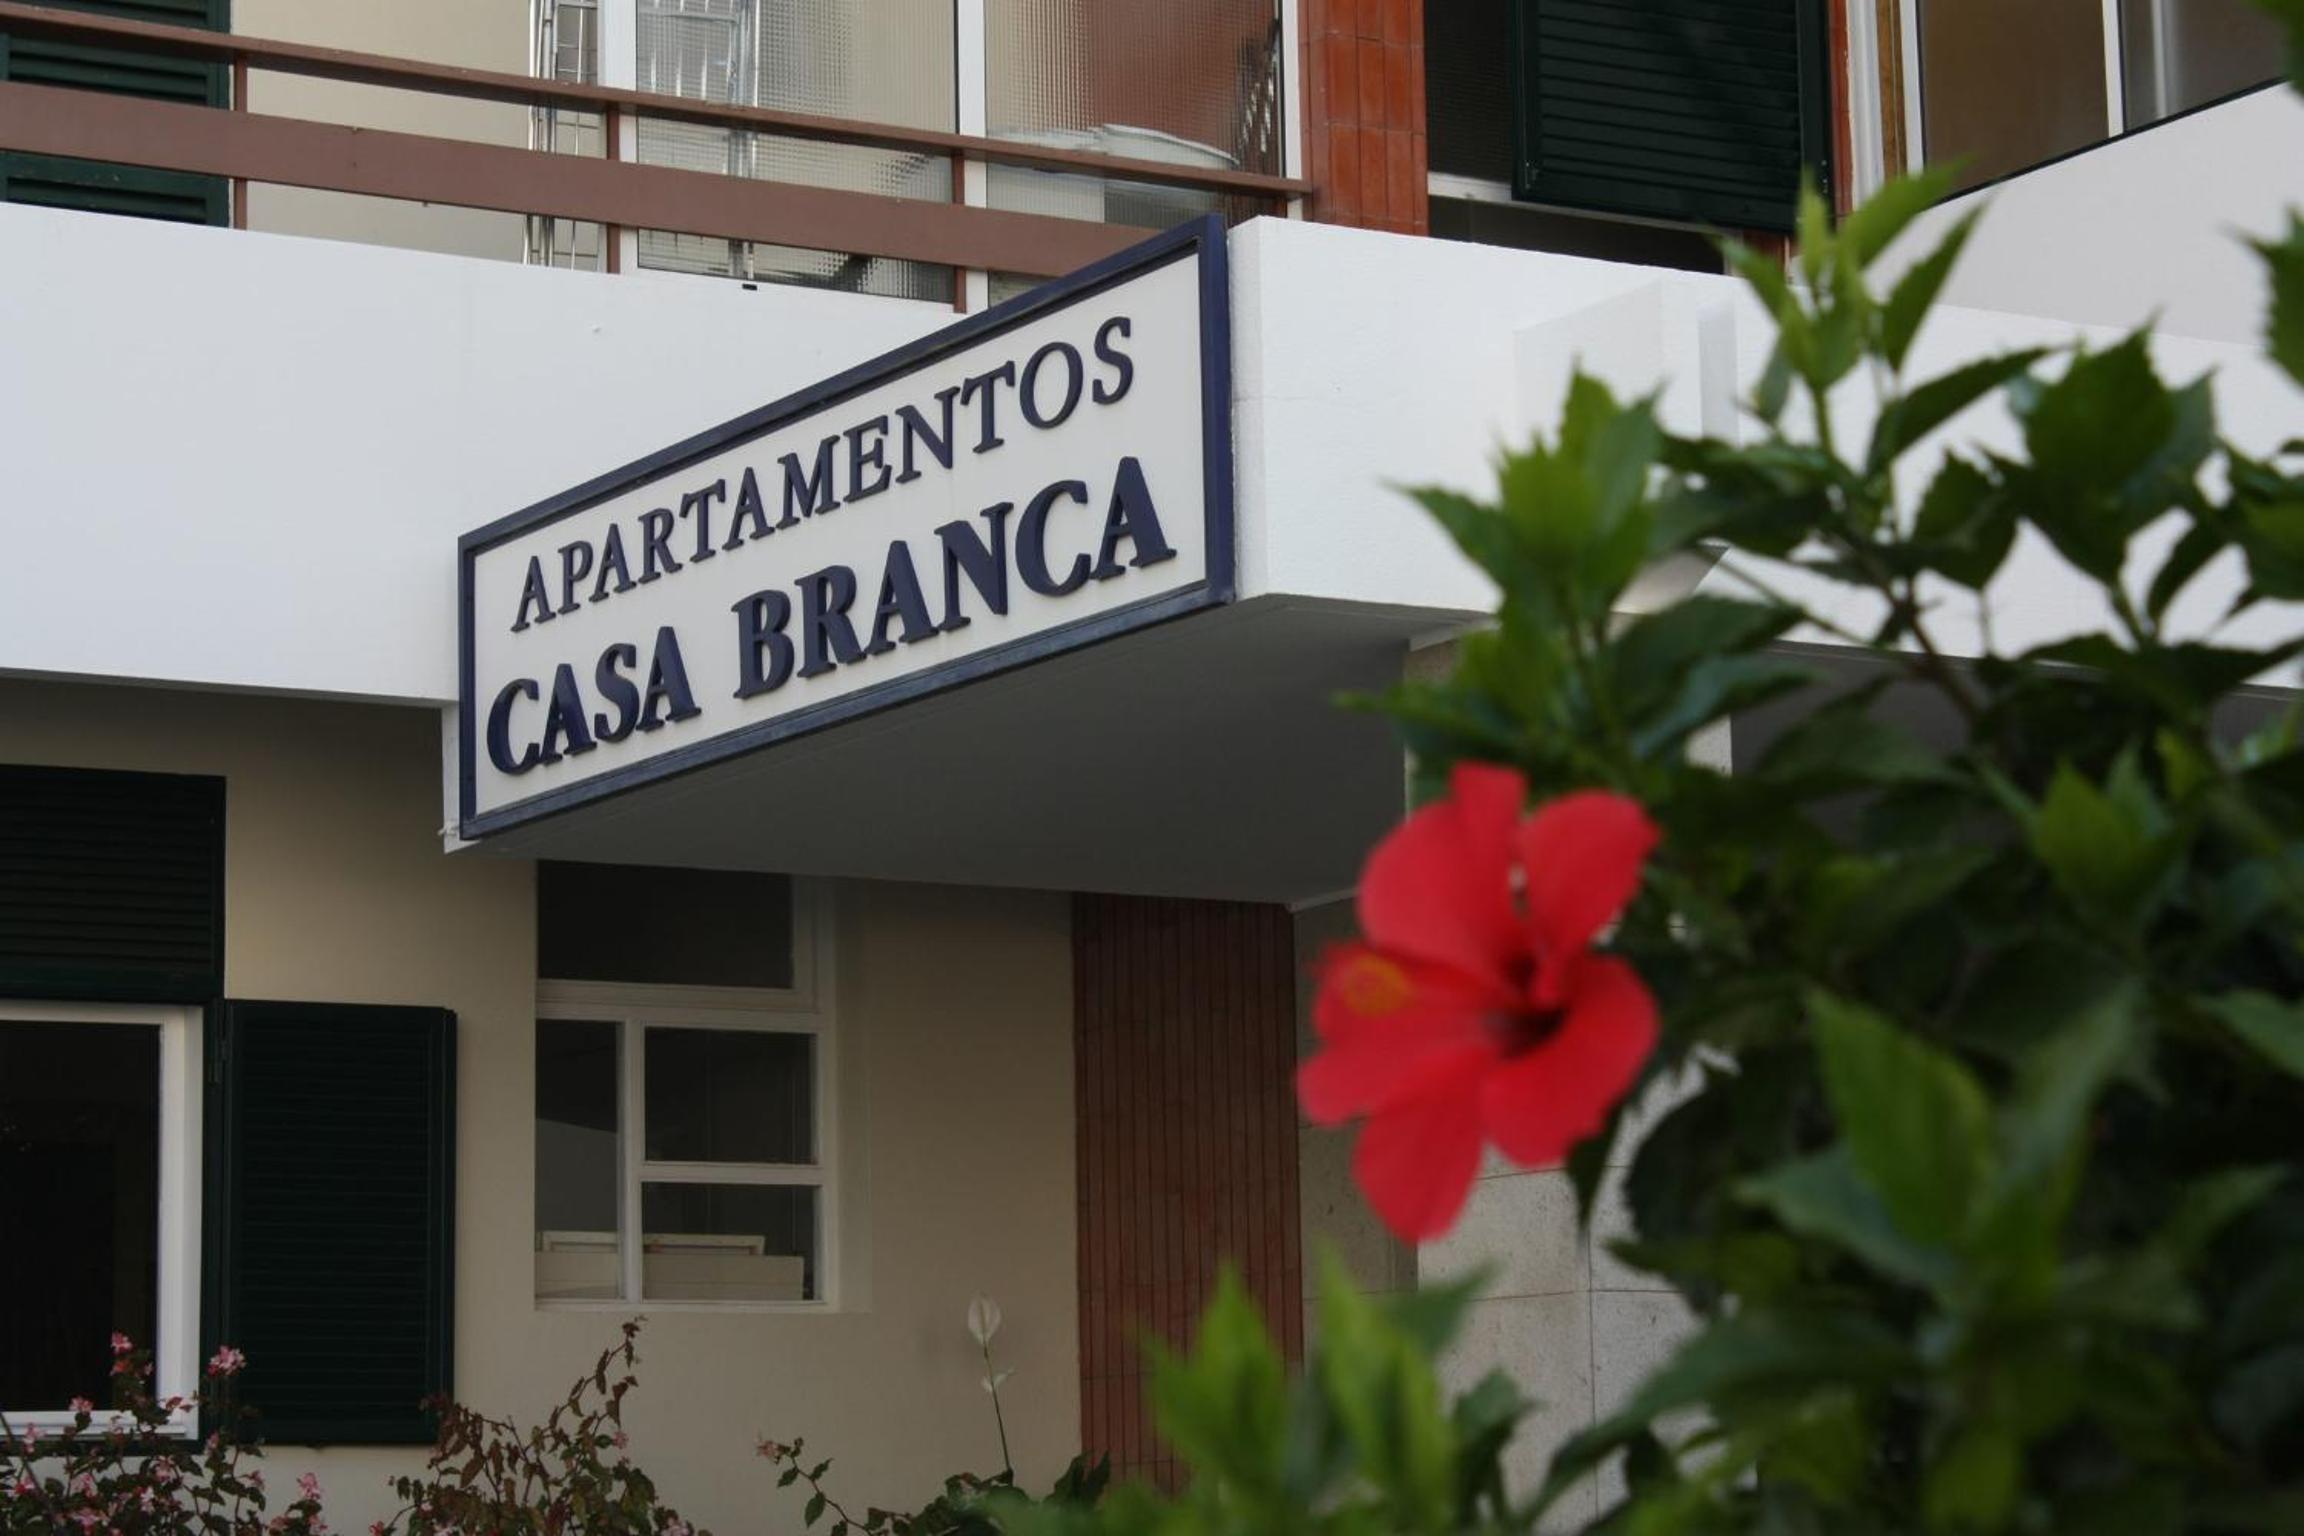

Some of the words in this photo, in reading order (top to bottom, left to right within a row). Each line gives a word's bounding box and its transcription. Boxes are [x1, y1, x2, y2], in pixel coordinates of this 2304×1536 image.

[487, 626, 701, 776] CASA
[731, 456, 1177, 700] BRANCA
[511, 316, 1134, 632] APARTAMENTOS
